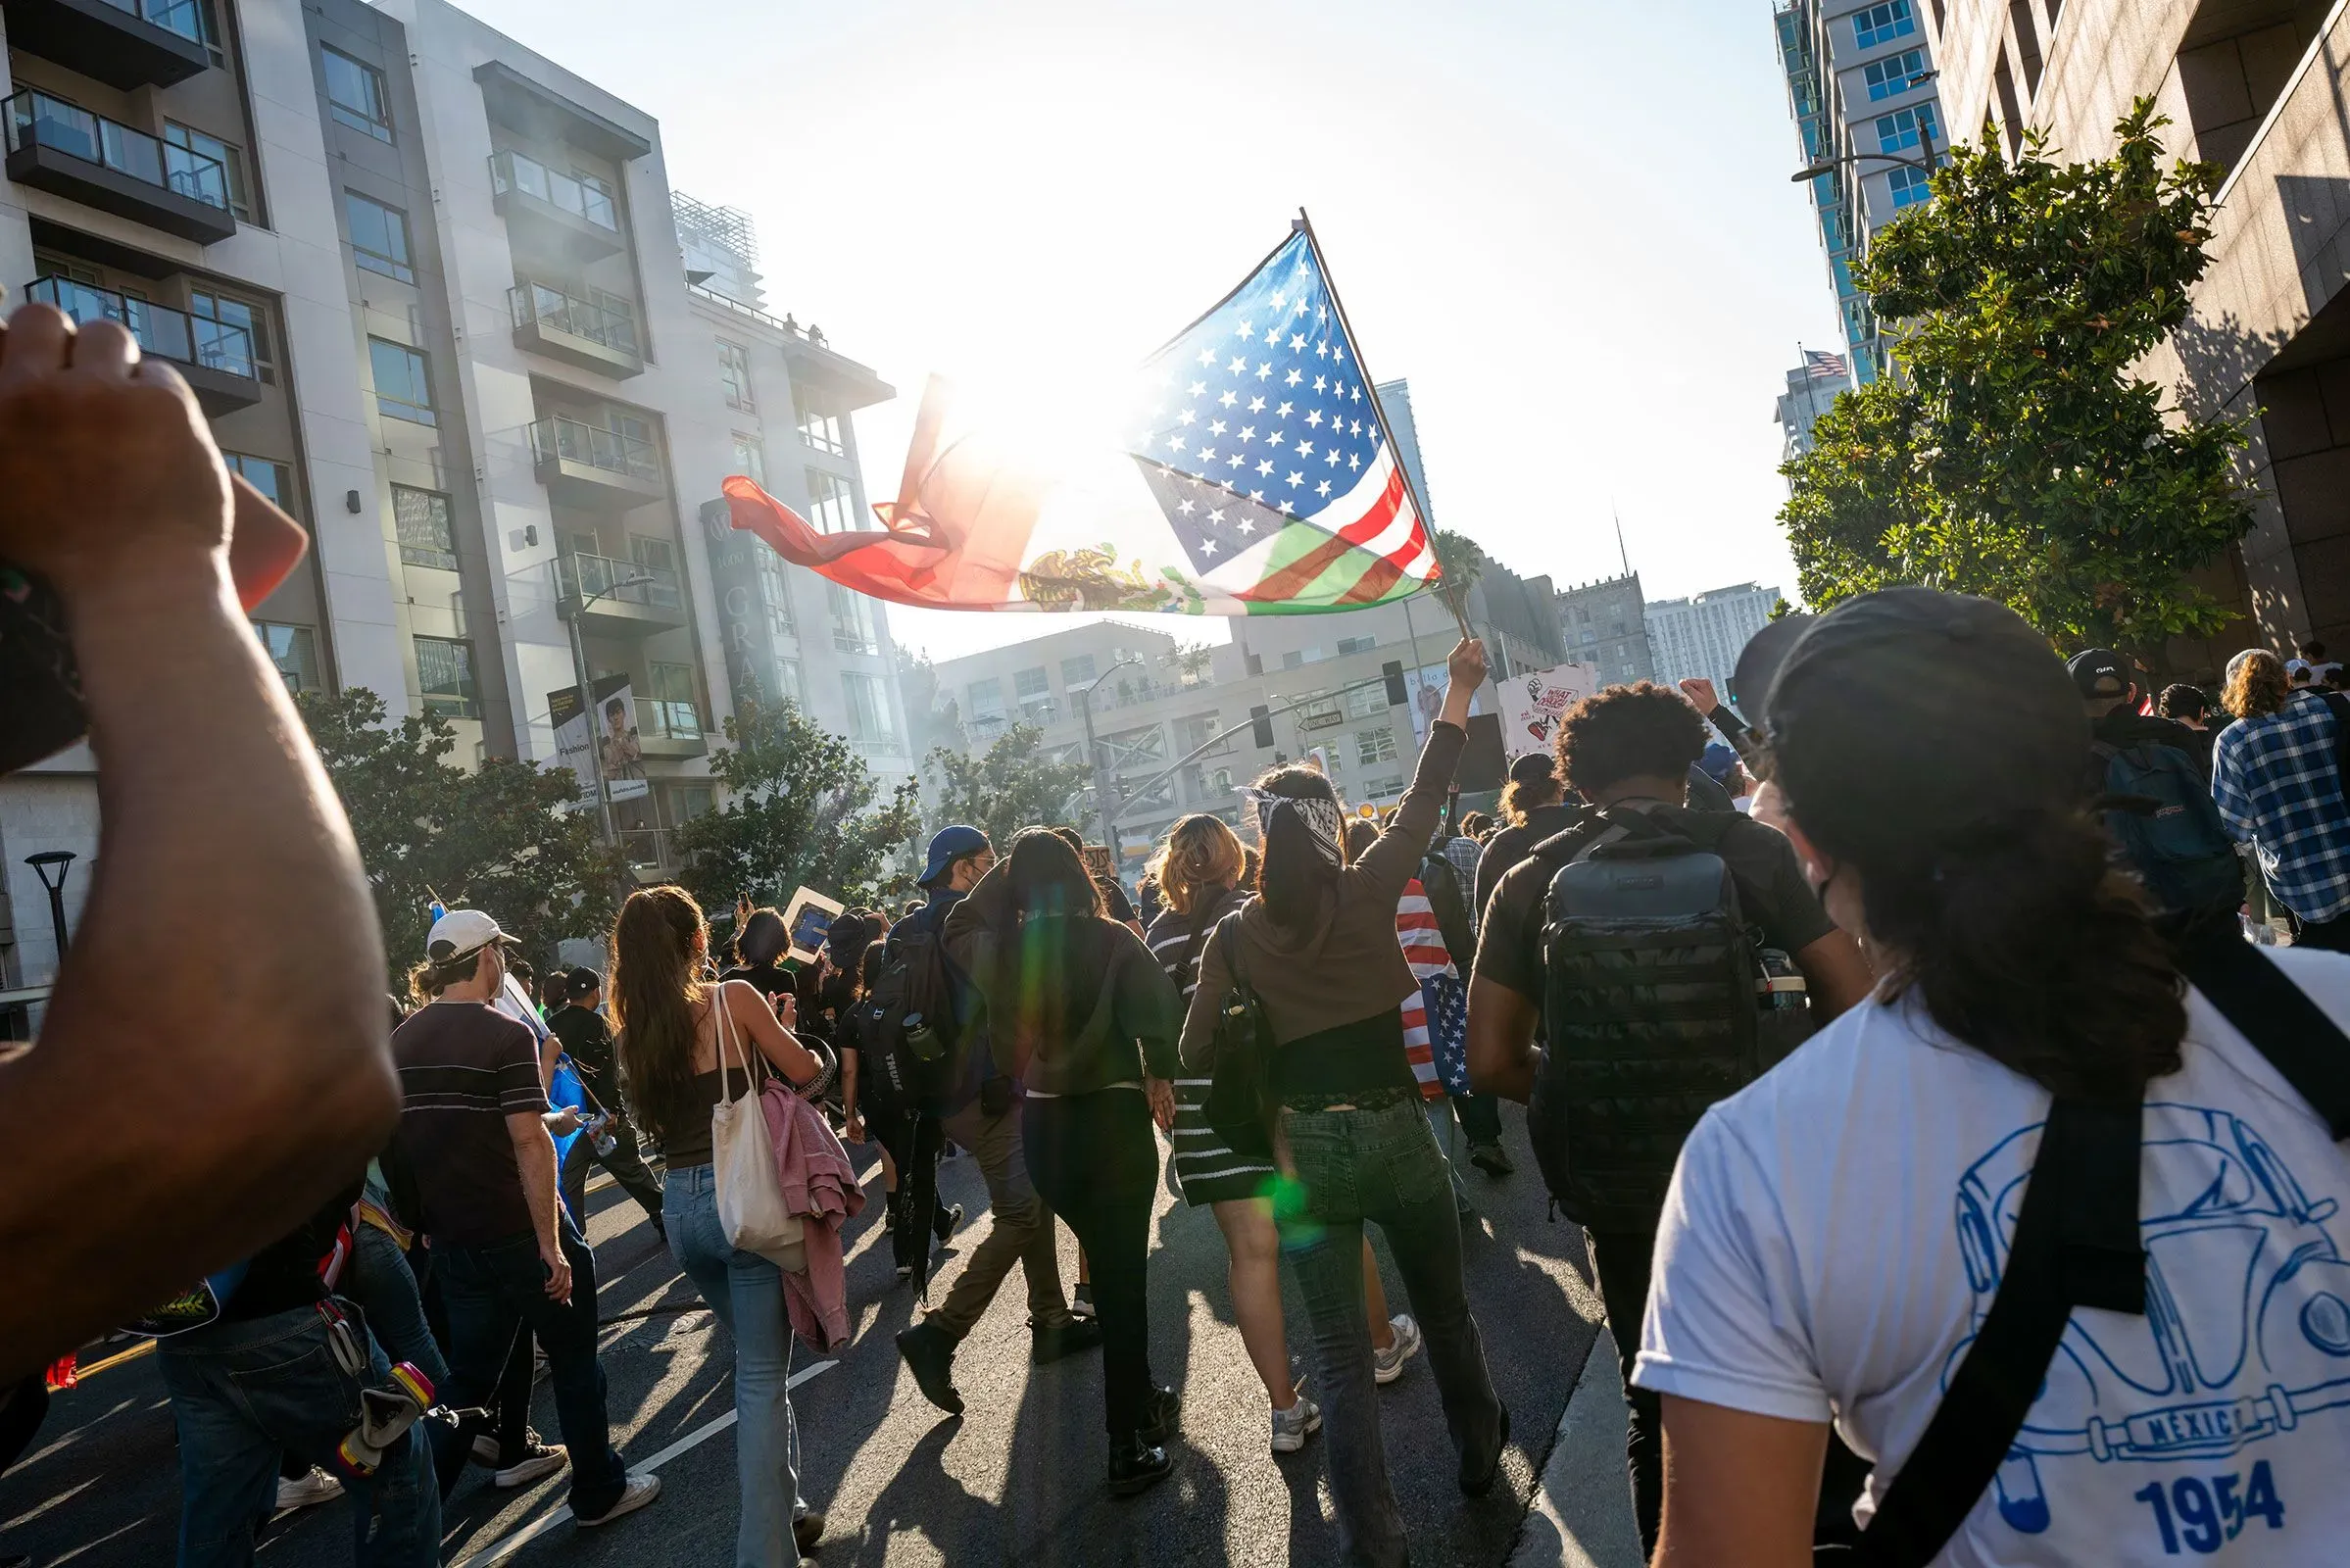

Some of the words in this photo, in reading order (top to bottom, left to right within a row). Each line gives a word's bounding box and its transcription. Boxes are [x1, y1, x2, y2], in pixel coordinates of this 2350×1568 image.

[724, 586, 765, 706] GRA
[1410, 673, 1438, 685] blla
[1307, 717, 1322, 727] ONE
[1324, 713, 1339, 723] WAY
[560, 743, 590, 757] Fashion
[1084, 849, 1110, 868] SIST
[885, 1053, 904, 1091] THULE
[2134, 1459, 2285, 1554] 1954
